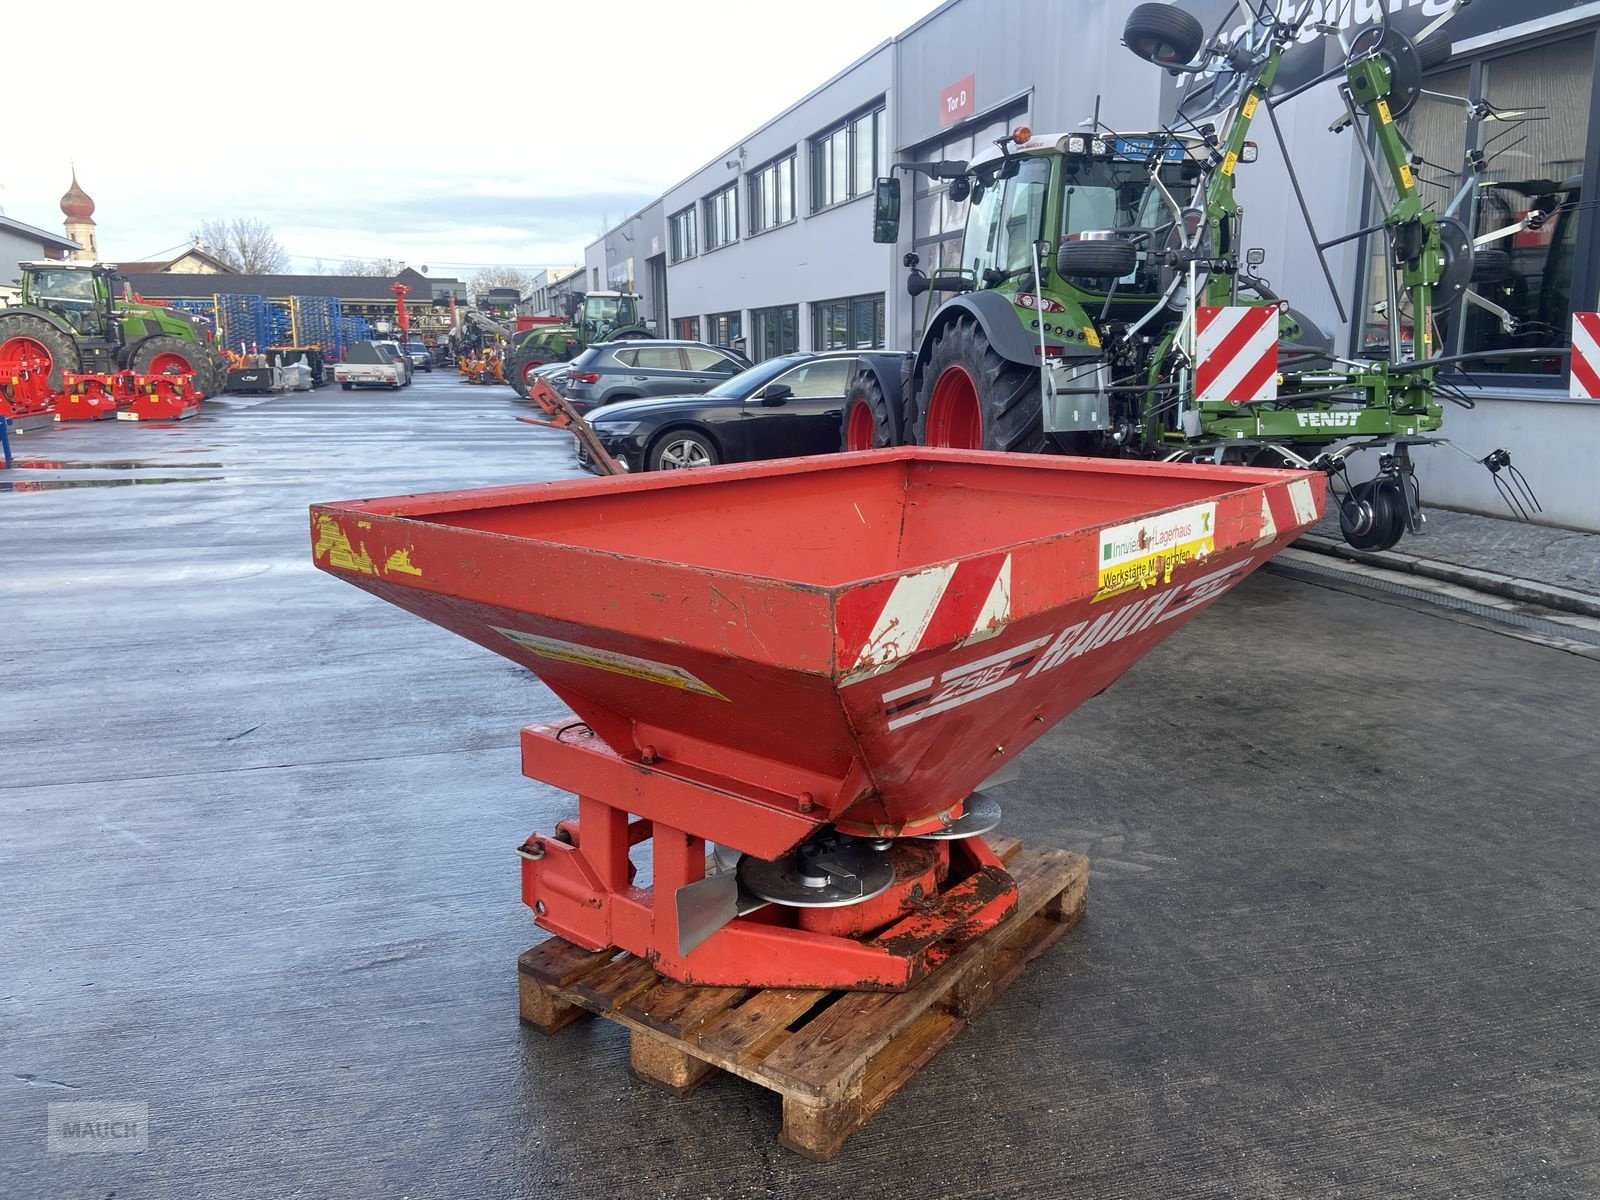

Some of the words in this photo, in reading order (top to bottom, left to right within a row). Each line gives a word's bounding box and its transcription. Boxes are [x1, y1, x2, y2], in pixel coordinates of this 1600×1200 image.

[946, 96, 959, 113] Tor
[960, 90, 967, 107] D
[1296, 411, 1362, 427] FENDT
[1154, 523, 1192, 546] Lagerhaus
[1103, 565, 1147, 586] Werkstätte
[1025, 584, 1185, 679] RAUCH
